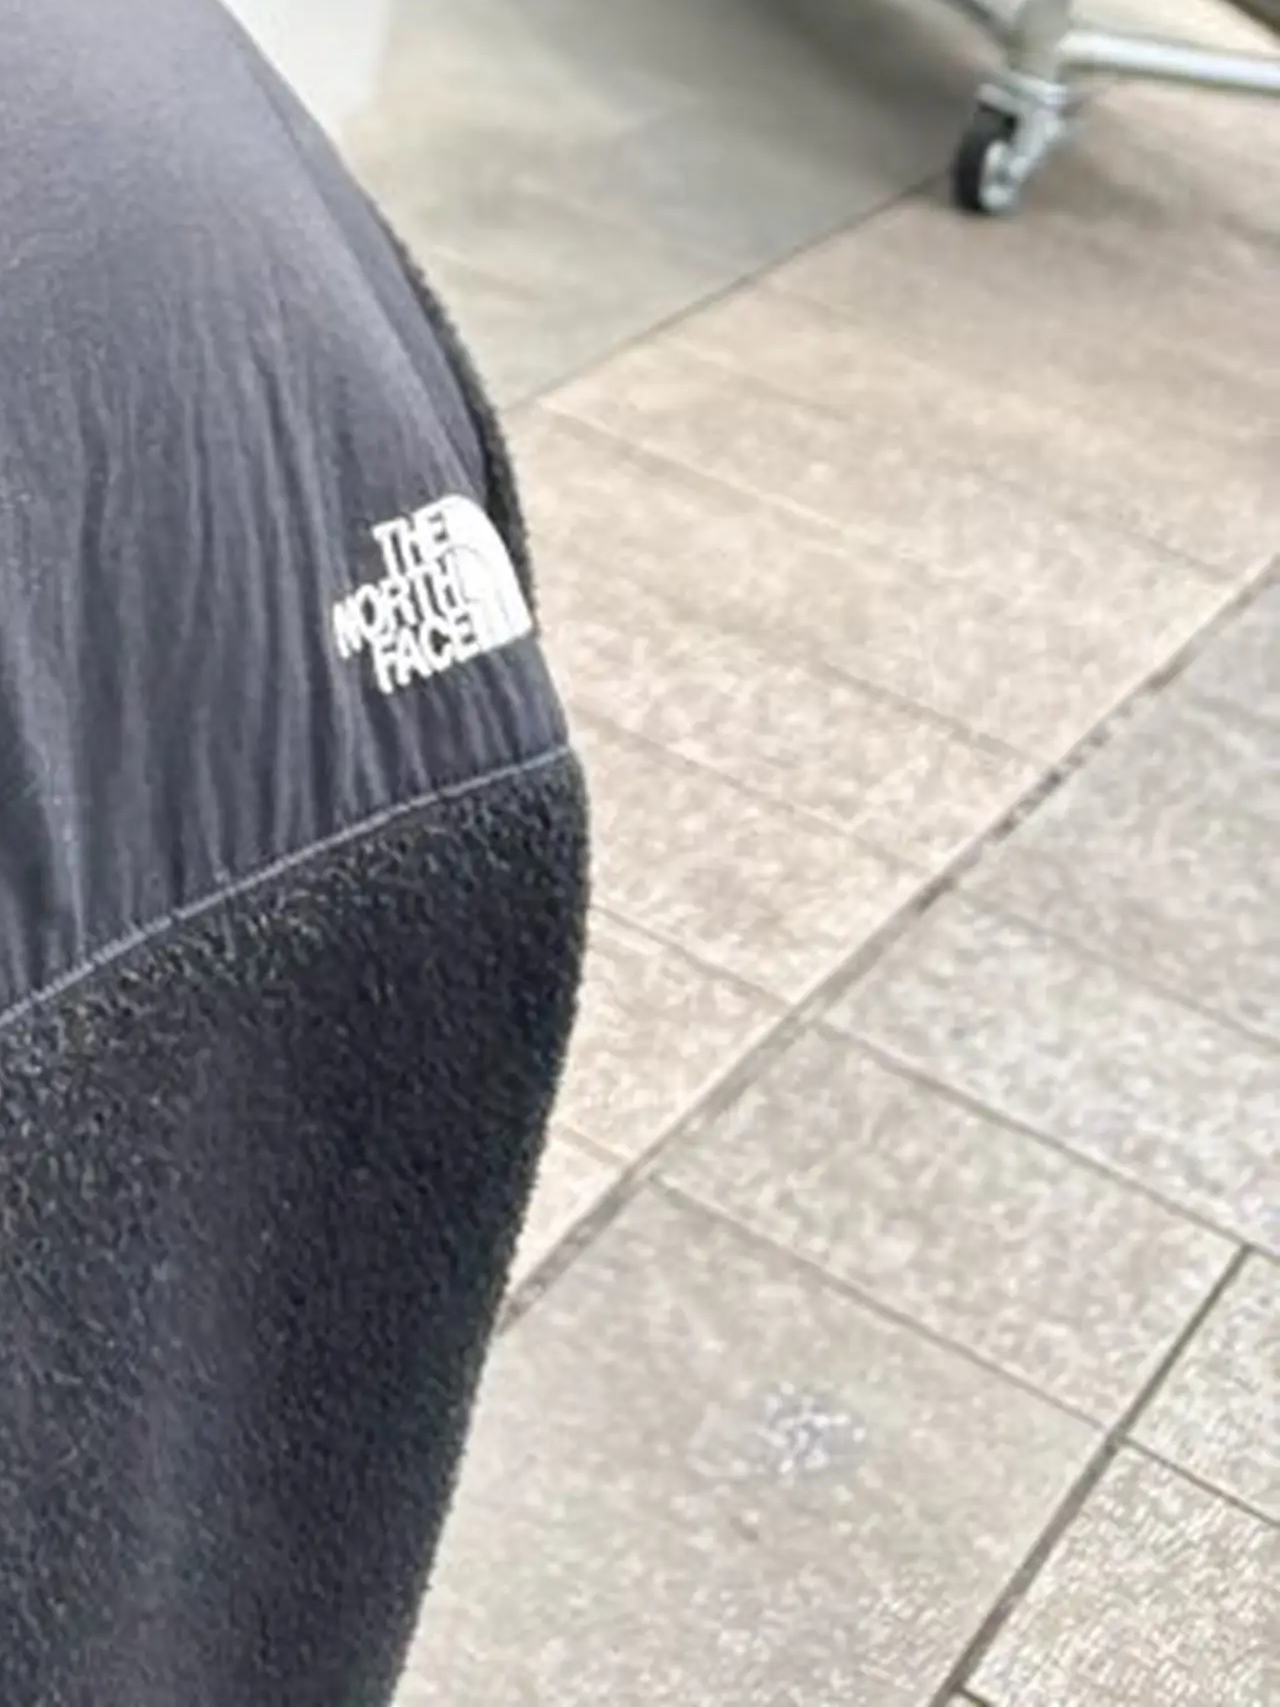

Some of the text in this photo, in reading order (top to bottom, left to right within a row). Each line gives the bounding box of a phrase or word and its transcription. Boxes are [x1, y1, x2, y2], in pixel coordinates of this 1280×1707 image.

[372, 507, 452, 583] THE
[332, 551, 469, 659] NORTH
[370, 607, 483, 694] FACE
